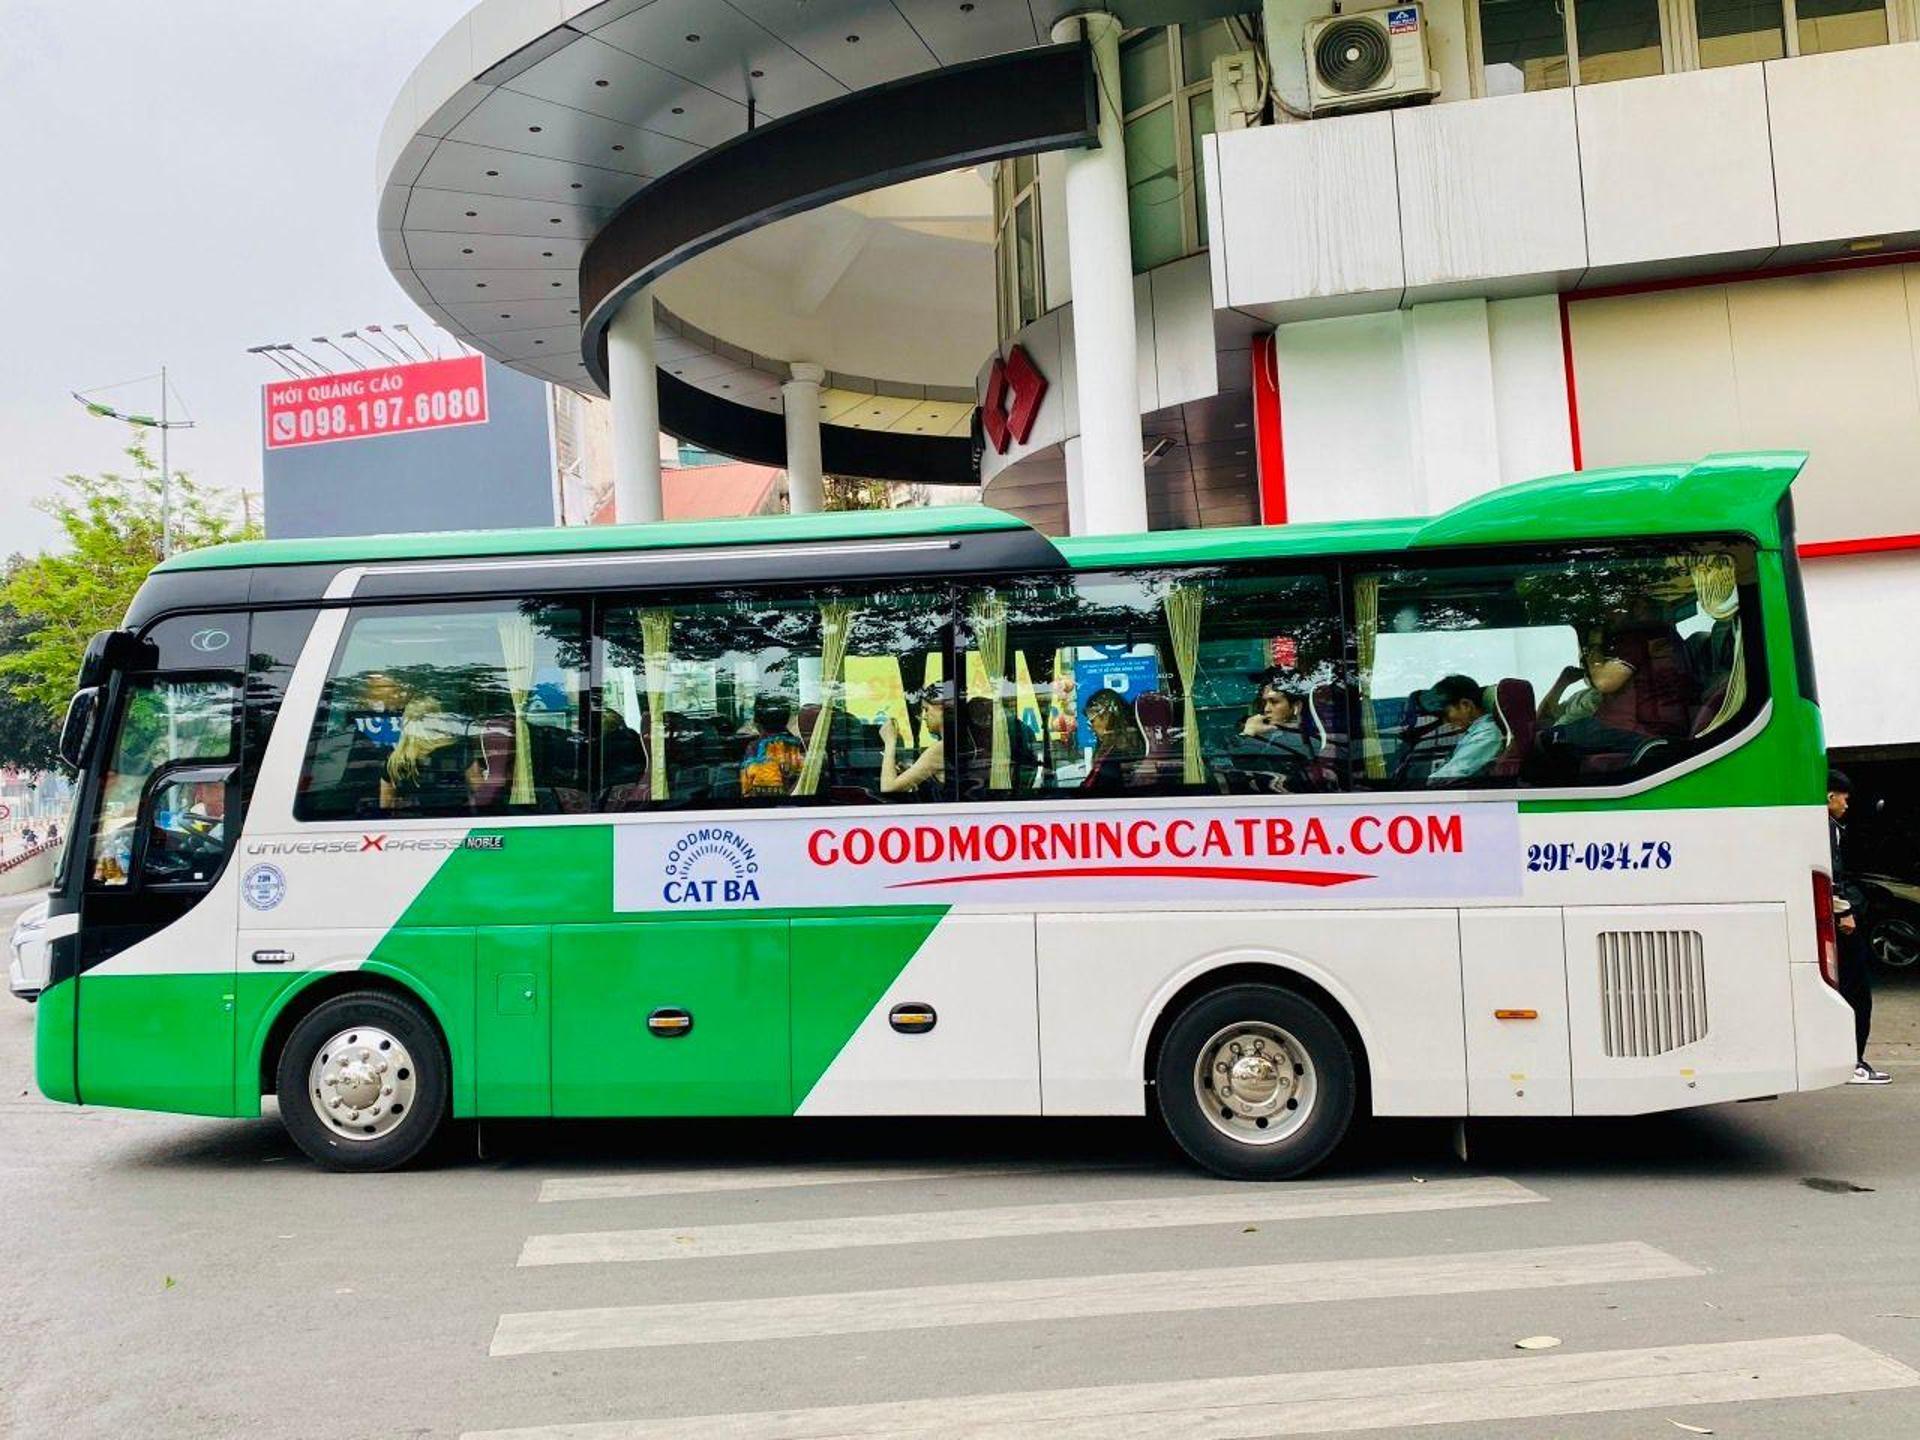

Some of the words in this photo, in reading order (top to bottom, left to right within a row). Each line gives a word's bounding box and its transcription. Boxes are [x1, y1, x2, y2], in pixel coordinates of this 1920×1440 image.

[307, 380, 364, 402] QUẢNG
[369, 373, 403, 393] CÁO
[300, 386, 480, 438] 098.197.6080
[467, 837, 502, 848] NOBLE
[665, 828, 759, 876] GOODMORNING
[808, 814, 1463, 866] GOODMORNINGCATBA.COM
[1527, 841, 1672, 872] 29F-024.78
[663, 881, 718, 903] CAT
[724, 879, 760, 902] BA
